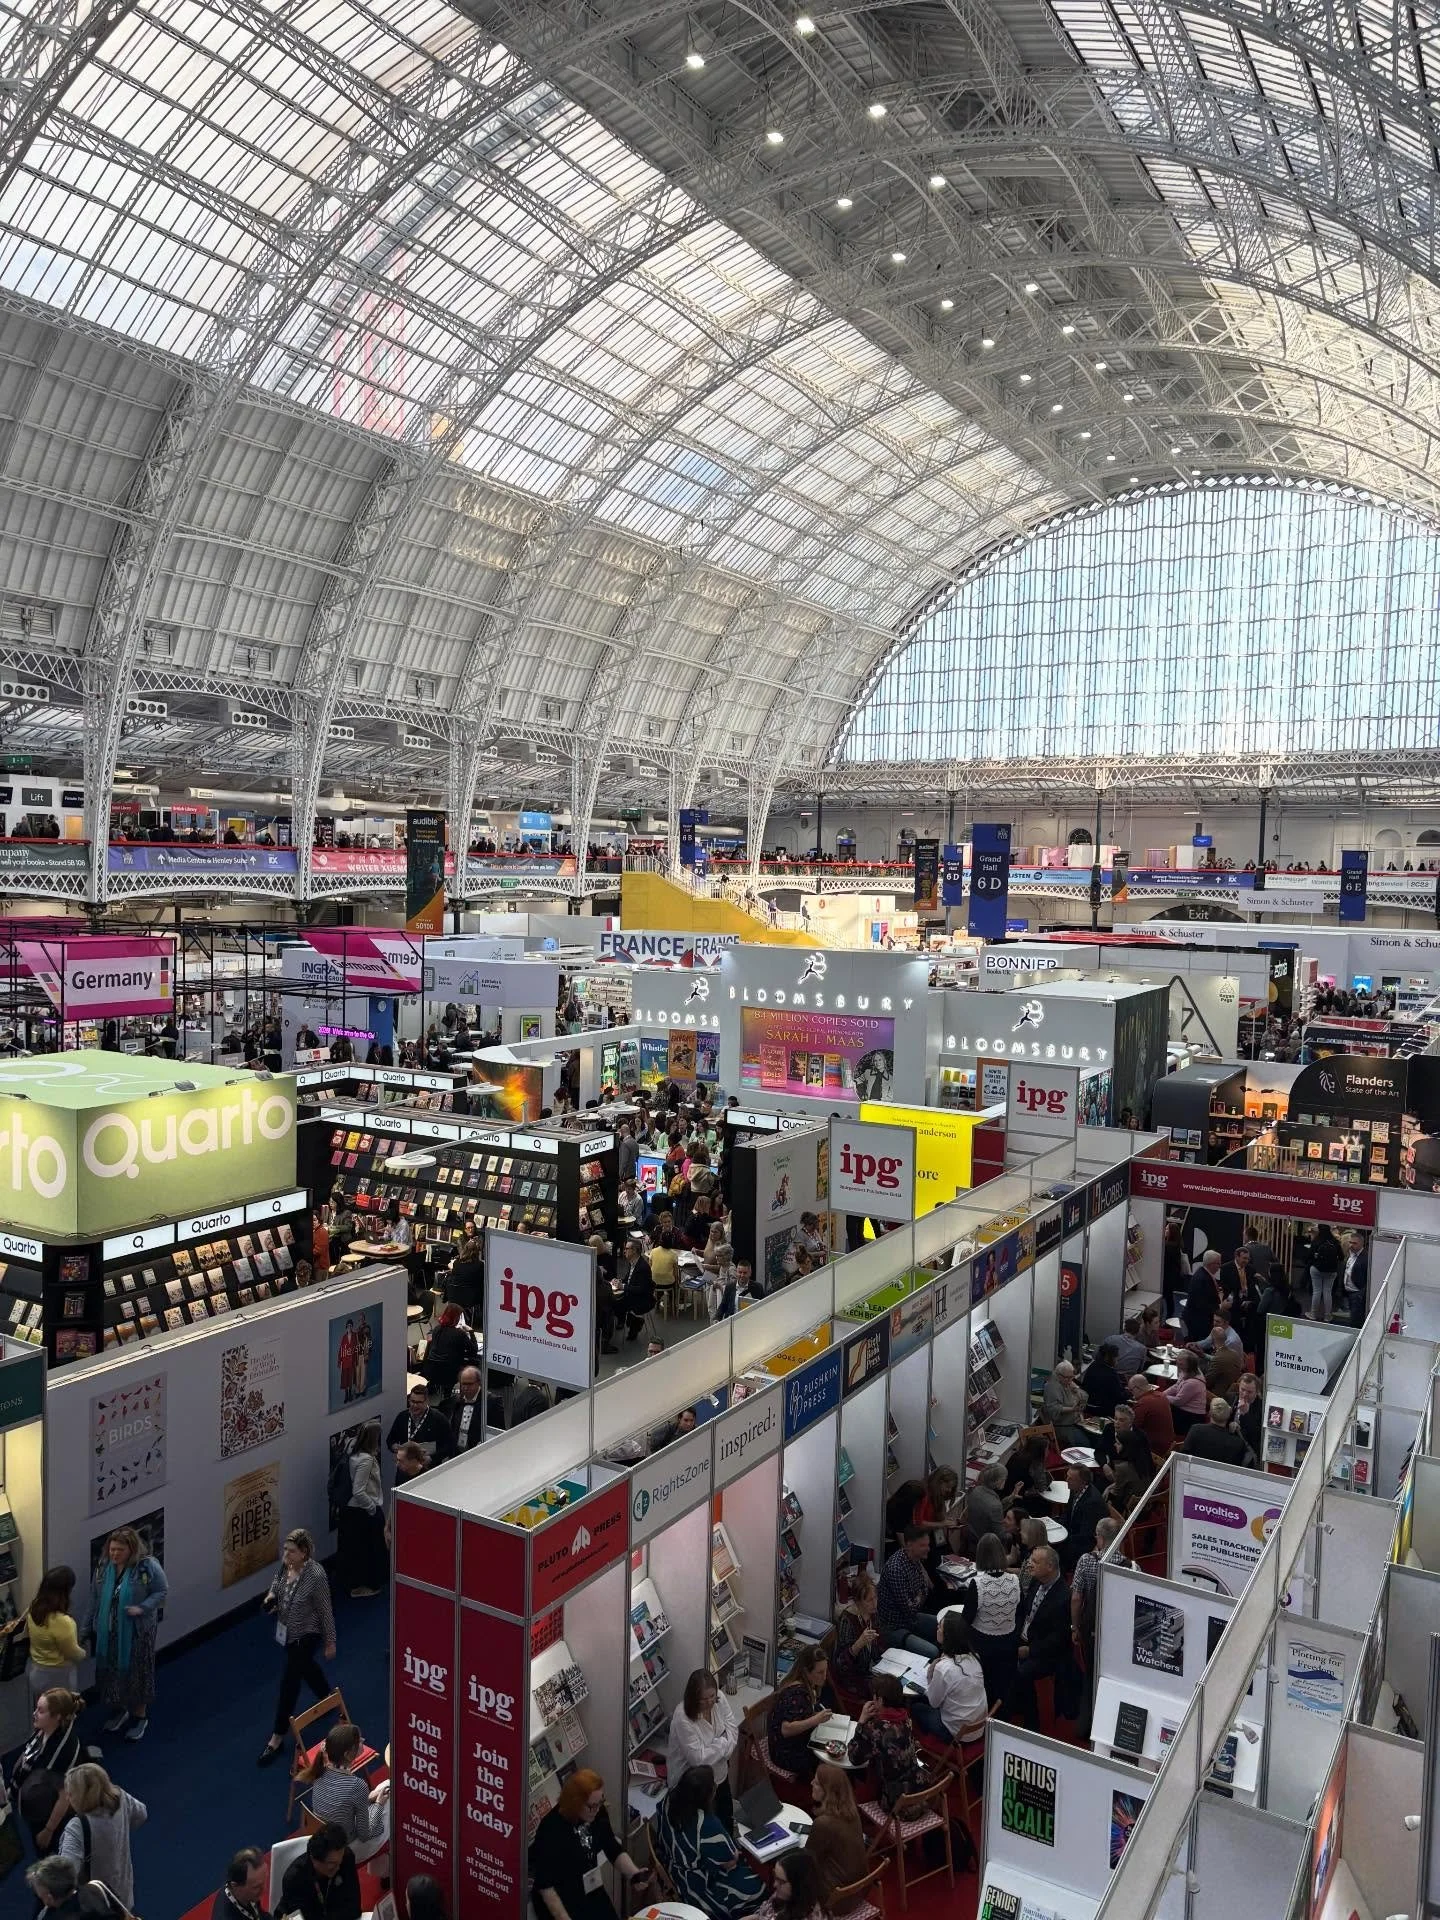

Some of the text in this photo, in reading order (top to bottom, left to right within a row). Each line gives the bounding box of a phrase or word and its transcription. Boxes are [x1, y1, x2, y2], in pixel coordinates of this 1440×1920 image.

[30, 794, 44, 802] Lift
[412, 817, 438, 826] audible
[212, 856, 232, 865] Henley
[348, 864, 379, 872] WRITER
[978, 877, 1002, 890] 6 D
[1346, 883, 1352, 891] 6
[1246, 897, 1270, 906] Simon
[1281, 898, 1314, 906] Schuster
[1189, 910, 1209, 920] Exit
[1132, 928, 1204, 939] Simon & Schuster
[1370, 937, 1440, 948] Simon & Schus
[600, 934, 685, 956] FRANCE
[331, 959, 387, 974] Germany
[72, 970, 152, 990] Germany
[729, 985, 914, 1012] BLOOMSBURY
[635, 1009, 720, 1027] BLOOMSB
[754, 1011, 766, 1020] 84
[771, 1012, 808, 1023] MILLION
[812, 1016, 848, 1026] COPIES
[851, 1018, 878, 1029] SOLD
[642, 1042, 668, 1052] Whistler
[766, 1030, 864, 1048] SARAH J. MAAS
[946, 1035, 1108, 1062] BLOOMSBURY
[299, 1076, 306, 1084] Q
[324, 1069, 346, 1080] Quarto
[382, 1073, 406, 1084] Quarto
[430, 1078, 437, 1087] Q
[1346, 1075, 1394, 1087] Flanders
[1016, 1080, 1068, 1114] ipg
[374, 1117, 401, 1130] Quarto
[432, 1125, 440, 1135] Q
[749, 1116, 756, 1125] Q
[82, 1089, 293, 1178] Quarto
[918, 1128, 957, 1139] anderson
[533, 1139, 542, 1149] Q
[584, 1140, 607, 1153] Quarto
[840, 1144, 902, 1188] ipg
[1141, 1169, 1168, 1188] ipg
[840, 1184, 866, 1193] Independent
[1101, 1178, 1124, 1210] HOBBS
[1183, 1182, 1316, 1205] www.independentpublishersguild.com
[272, 1200, 282, 1212] Q
[1332, 1194, 1363, 1214] ipg
[191, 1213, 231, 1234] Quarto
[3, 1237, 37, 1256] Quarto
[132, 1235, 144, 1249] Q
[1062, 1275, 1070, 1290] 5
[500, 1268, 578, 1339] ipg
[1272, 1325, 1288, 1334] CPI
[499, 1328, 577, 1352] Independent Publishers Guild
[867, 1355, 881, 1370] Press
[1276, 1352, 1296, 1362] PRINT
[1275, 1360, 1324, 1375] DISTRIBUTION
[804, 1364, 839, 1395] PUSHKIN
[803, 1389, 826, 1413] PRESS
[110, 1415, 152, 1444] BIRDS
[720, 1407, 776, 1462] inspired:
[652, 1457, 710, 1504] RightsZone
[247, 1497, 259, 1508] THE
[1194, 1503, 1239, 1521] royalties
[232, 1500, 272, 1533] RIDER
[537, 1511, 622, 1572] PLUTO PRESS
[1192, 1533, 1261, 1555] SALES TRACKING
[1192, 1542, 1208, 1551] FOR
[1136, 1646, 1152, 1657] The
[1292, 1648, 1342, 1667] Plotting for
[403, 1647, 447, 1693] ipg
[1136, 1654, 1179, 1672] Watchers
[1297, 1659, 1335, 1676] Freedom
[468, 1674, 514, 1723] ipg
[408, 1713, 442, 1740] Join
[413, 1735, 437, 1758] the
[473, 1742, 509, 1771] Join
[411, 1754, 438, 1780] IPG
[1004, 1754, 1056, 1793] GENIUS
[477, 1766, 504, 1790] the
[403, 1772, 447, 1805] today
[1004, 1777, 1017, 1799] AT
[475, 1785, 504, 1812] IPG
[411, 1814, 439, 1834] Visit us
[466, 1803, 513, 1837] today
[1002, 1800, 1054, 1840] SCALE
[403, 1822, 448, 1849] at reception
[406, 1834, 444, 1859] to find out
[414, 1850, 436, 1866] more.
[475, 1847, 504, 1868] Visit us
[466, 1856, 513, 1884] at reception
[469, 1868, 509, 1894] to find out
[478, 1883, 502, 1901] more.
[986, 1886, 1016, 1913] GENIUS
[982, 1903, 993, 1919] AT
